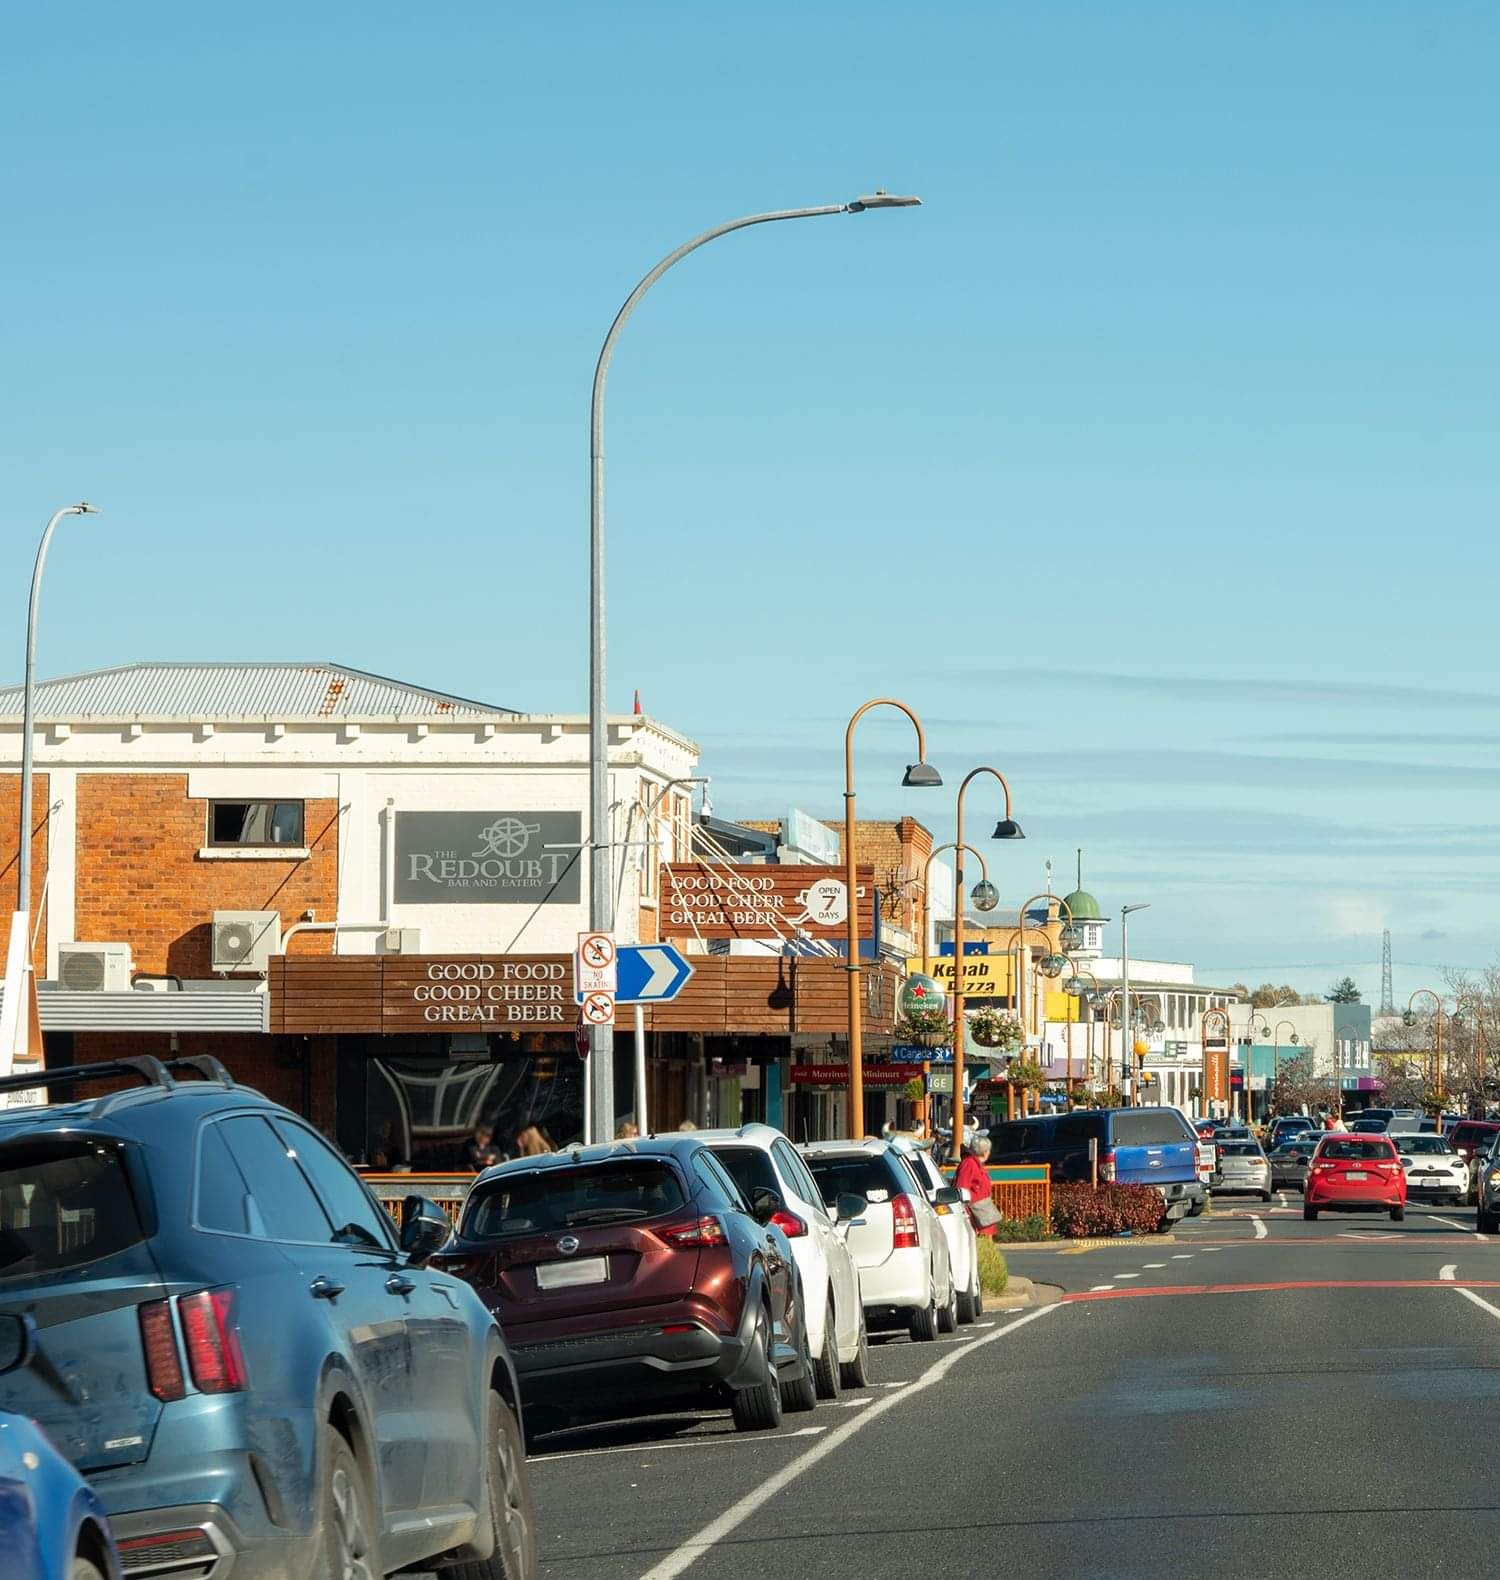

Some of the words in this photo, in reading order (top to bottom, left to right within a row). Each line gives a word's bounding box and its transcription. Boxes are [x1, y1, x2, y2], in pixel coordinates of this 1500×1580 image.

[433, 850, 458, 859] THE
[407, 853, 569, 884] REDOUBT
[448, 879, 470, 888] BAR
[473, 879, 498, 888] AND
[502, 879, 544, 888] EATERY
[671, 877, 722, 891] GOOD
[729, 877, 775, 891] FOOD
[818, 886, 841, 895] OPEN
[671, 894, 722, 907] GOOD
[727, 894, 785, 908] CHEER
[822, 895, 837, 911] 7
[670, 911, 730, 925] GREAT
[734, 911, 777, 925] BEER
[818, 911, 840, 920] DAYS
[427, 964, 495, 981] GOOD
[502, 963, 566, 980] FOOD
[593, 970, 603, 979] NO
[932, 962, 989, 978] Keab
[413, 985, 481, 1002] GOOD
[487, 985, 565, 1001] CHEER
[424, 1005, 500, 1022] GREAT
[507, 1005, 565, 1021] BEER
[900, 1047, 932, 1059] Canada
[935, 1047, 945, 1059] St
[862, 1070, 900, 1079] Minimart
